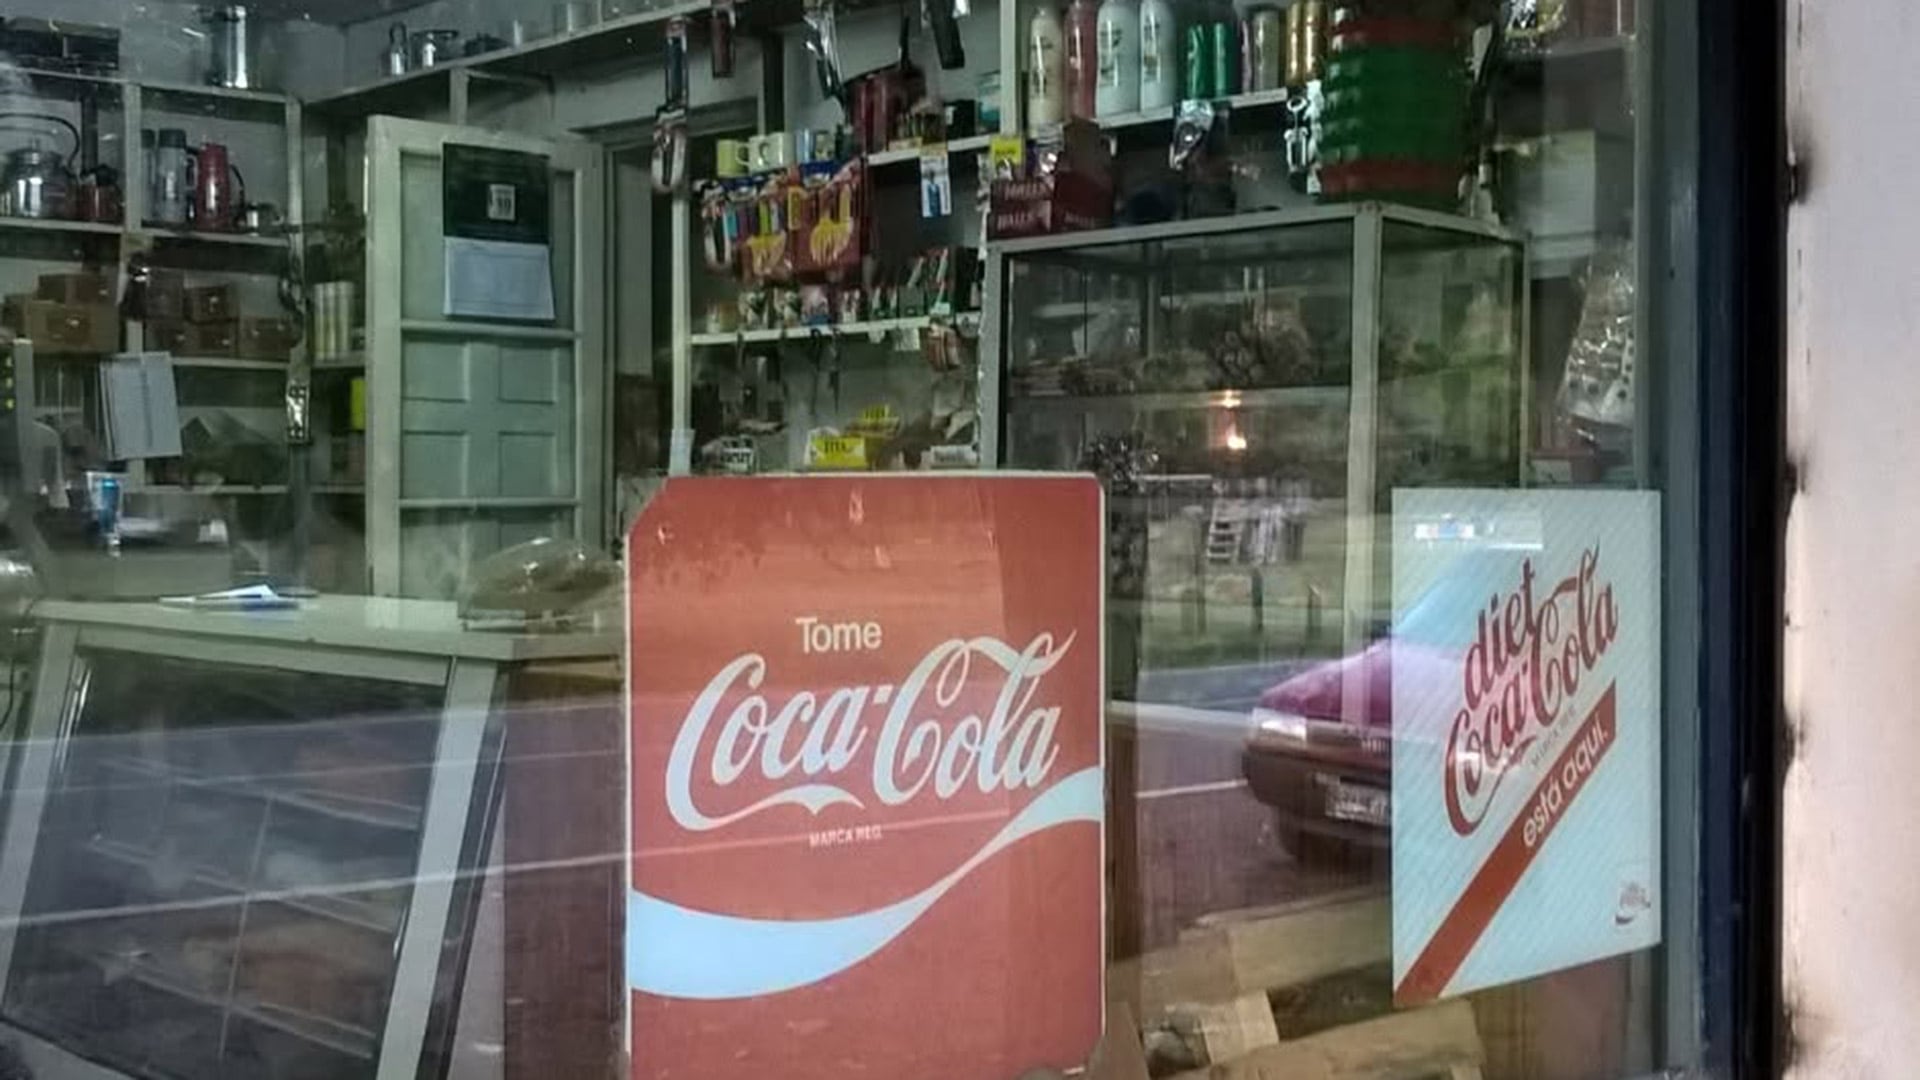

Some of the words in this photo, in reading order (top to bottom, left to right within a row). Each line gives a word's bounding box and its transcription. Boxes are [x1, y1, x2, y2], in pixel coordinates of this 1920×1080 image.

[795, 617, 882, 653] Tome
[1445, 539, 1618, 836] Coca-Cola
[1464, 557, 1535, 710] diet
[666, 630, 1076, 830] Coca-Cola
[808, 828, 854, 848] MARCA
[1523, 776, 1562, 847] está
